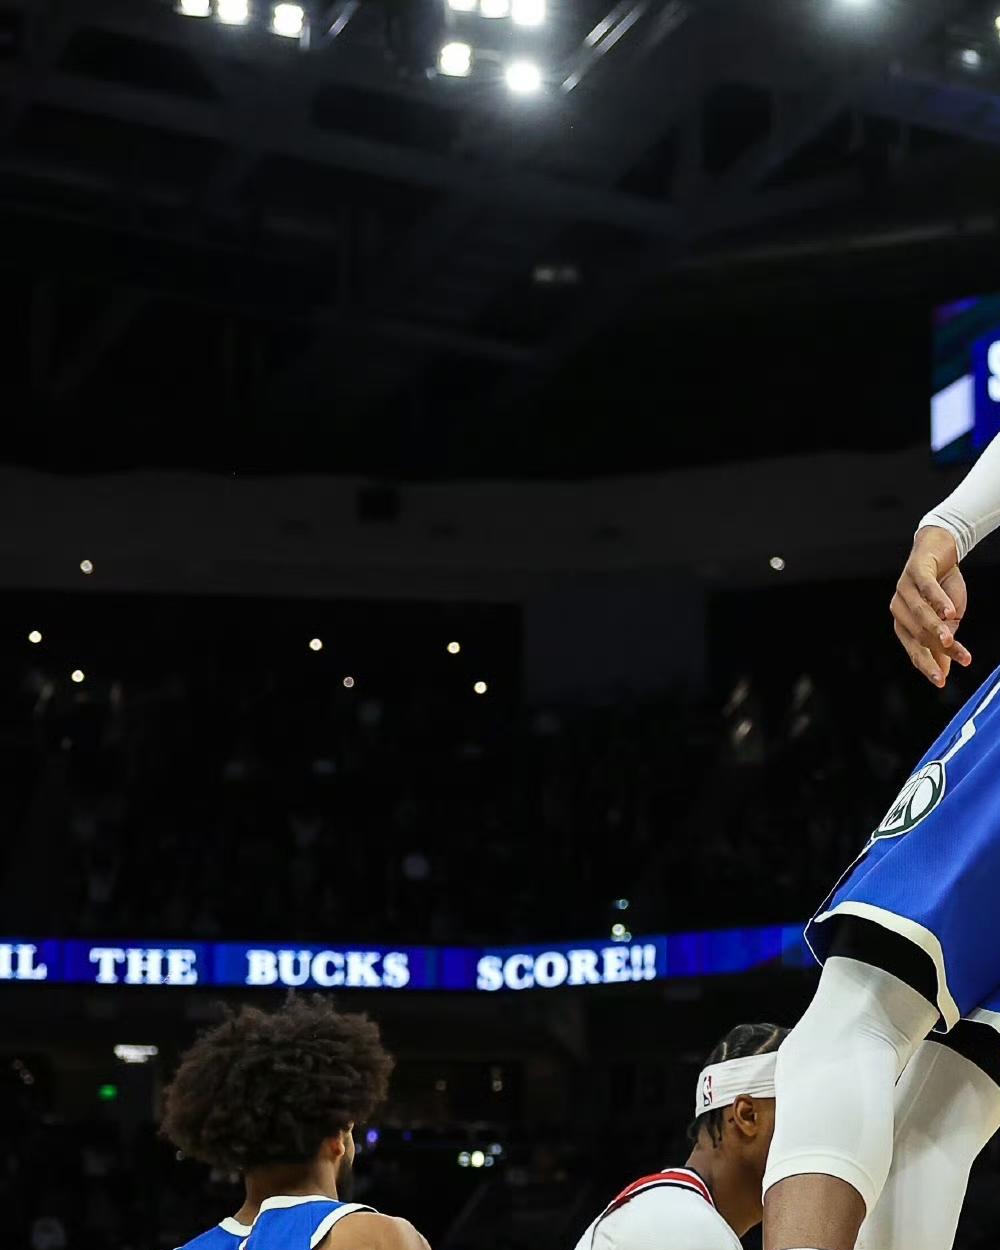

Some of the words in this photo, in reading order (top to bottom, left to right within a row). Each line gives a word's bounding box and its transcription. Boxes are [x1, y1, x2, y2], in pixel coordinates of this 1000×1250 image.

[89, 947, 198, 986] THE
[245, 949, 410, 988] BUCKS
[475, 943, 656, 992] SCORE!!
